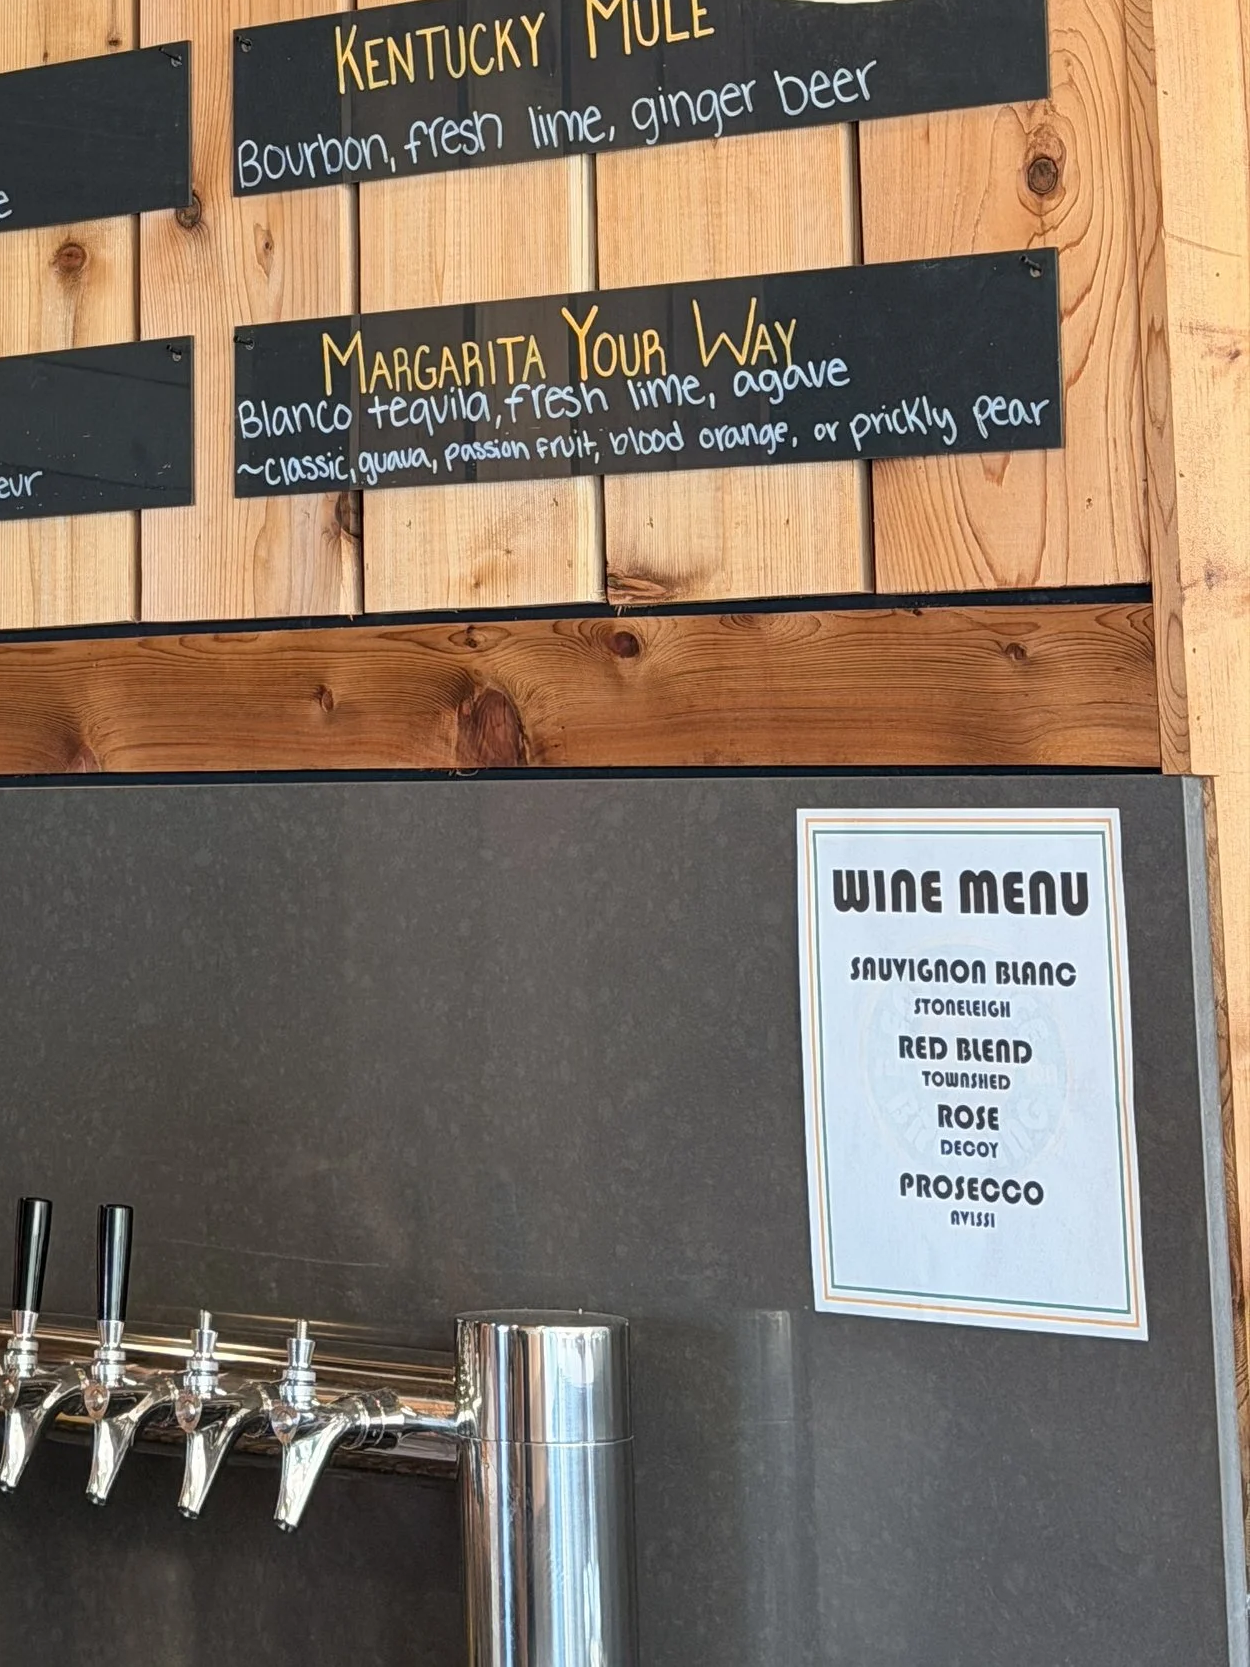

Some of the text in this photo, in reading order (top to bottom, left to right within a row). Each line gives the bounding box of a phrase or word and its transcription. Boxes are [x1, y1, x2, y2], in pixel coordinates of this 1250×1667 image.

[334, 12, 546, 94] KENTUCKY
[237, 59, 878, 190] Bourbon, fresh lime, ginger beer
[322, 297, 797, 396] MARGARITA YOUR WAY
[237, 357, 850, 440] Blanco tequila, fresh lime, agave
[358, 443, 437, 486] guava,
[444, 437, 530, 472] passion
[535, 434, 599, 464] fruit,
[609, 421, 683, 456] blood
[699, 419, 798, 455] orange,
[814, 420, 839, 442] or
[849, 395, 957, 451] prickly
[974, 394, 1050, 438] pear
[832, 869, 1089, 917] WINE MENU
[850, 956, 1077, 987] SAUVIGNON BLANC
[914, 998, 1011, 1018] STONELEIGH
[899, 1035, 1033, 1064] RED BLEND
[922, 1070, 1011, 1090] TOWNSHED
[938, 1104, 999, 1131] ROSE
[940, 1139, 999, 1158] DECOY
[900, 1172, 1044, 1206] PROSECCO
[950, 1210, 995, 1228] AVISSI
